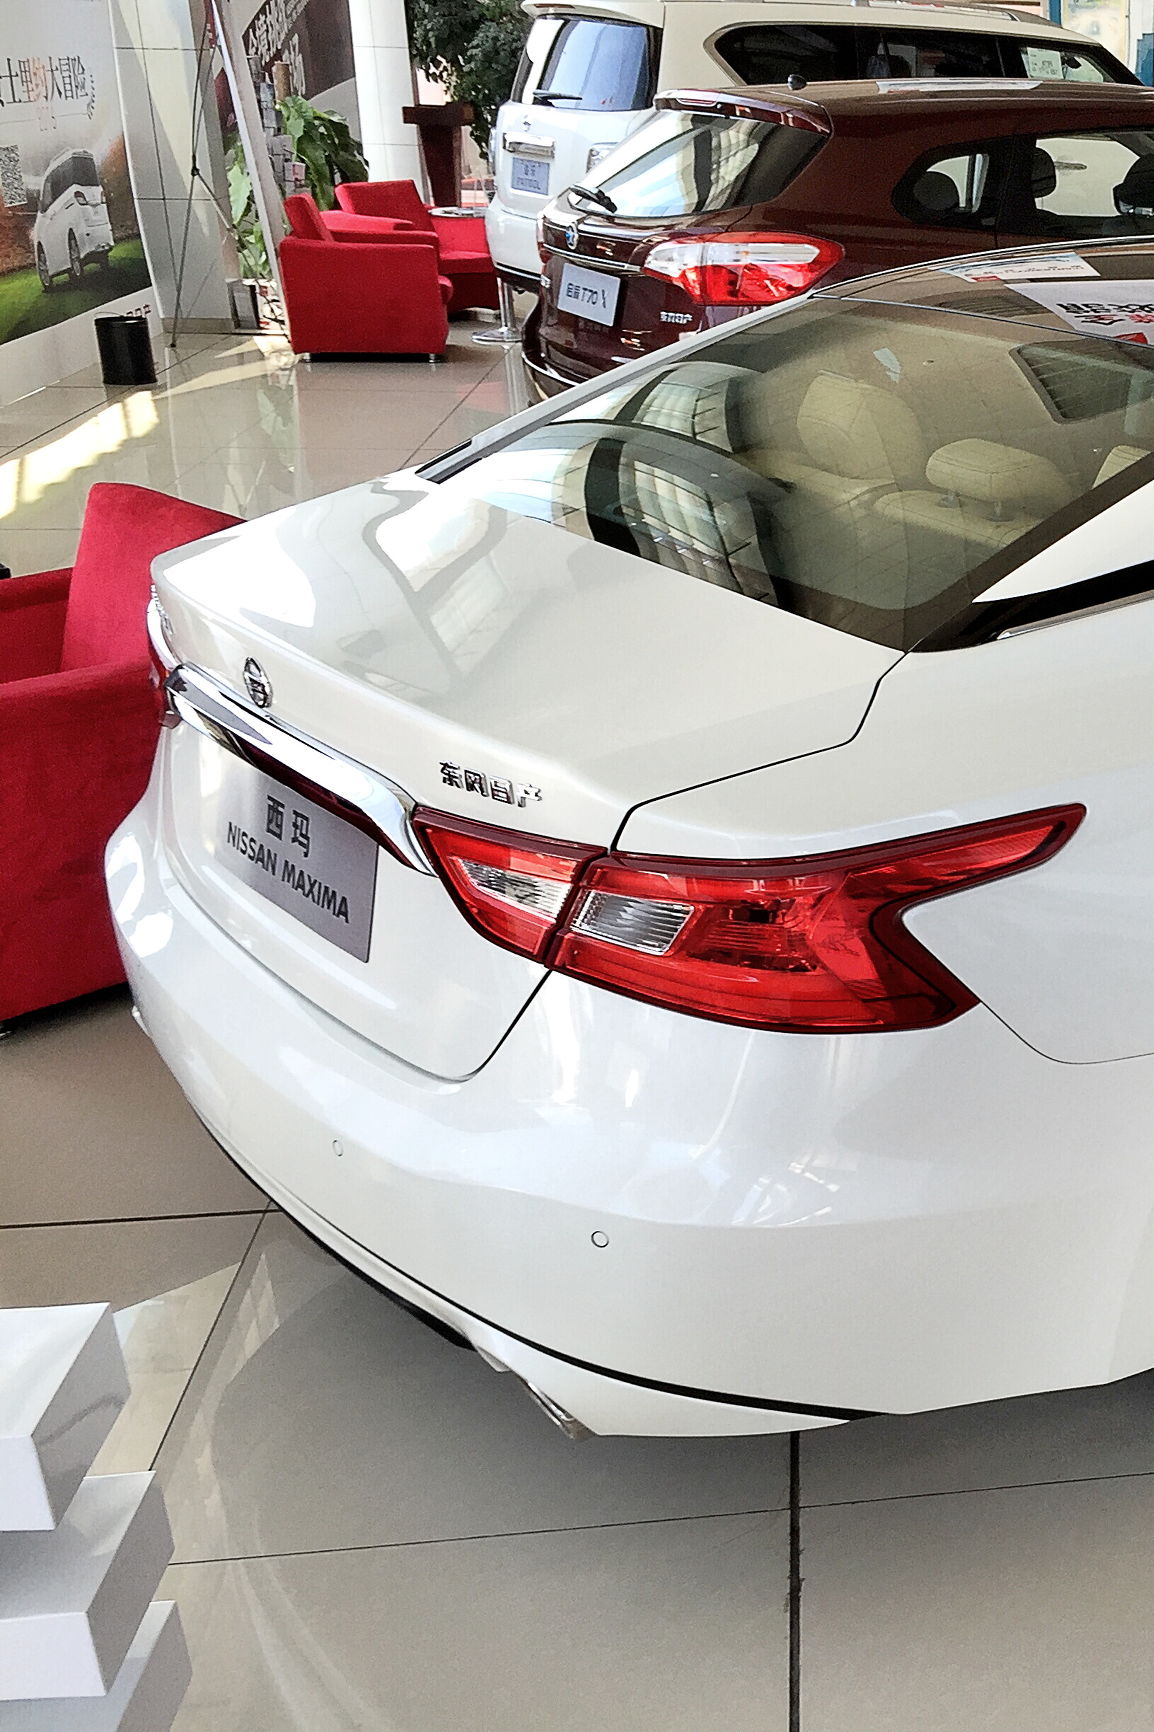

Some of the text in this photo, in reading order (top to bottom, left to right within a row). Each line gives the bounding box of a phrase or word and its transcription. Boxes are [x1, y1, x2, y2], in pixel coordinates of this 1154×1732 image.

[439, 760, 543, 808] 东风日产
[265, 794, 312, 858] 西玛
[227, 821, 350, 924] NISSAN MAXIMA
